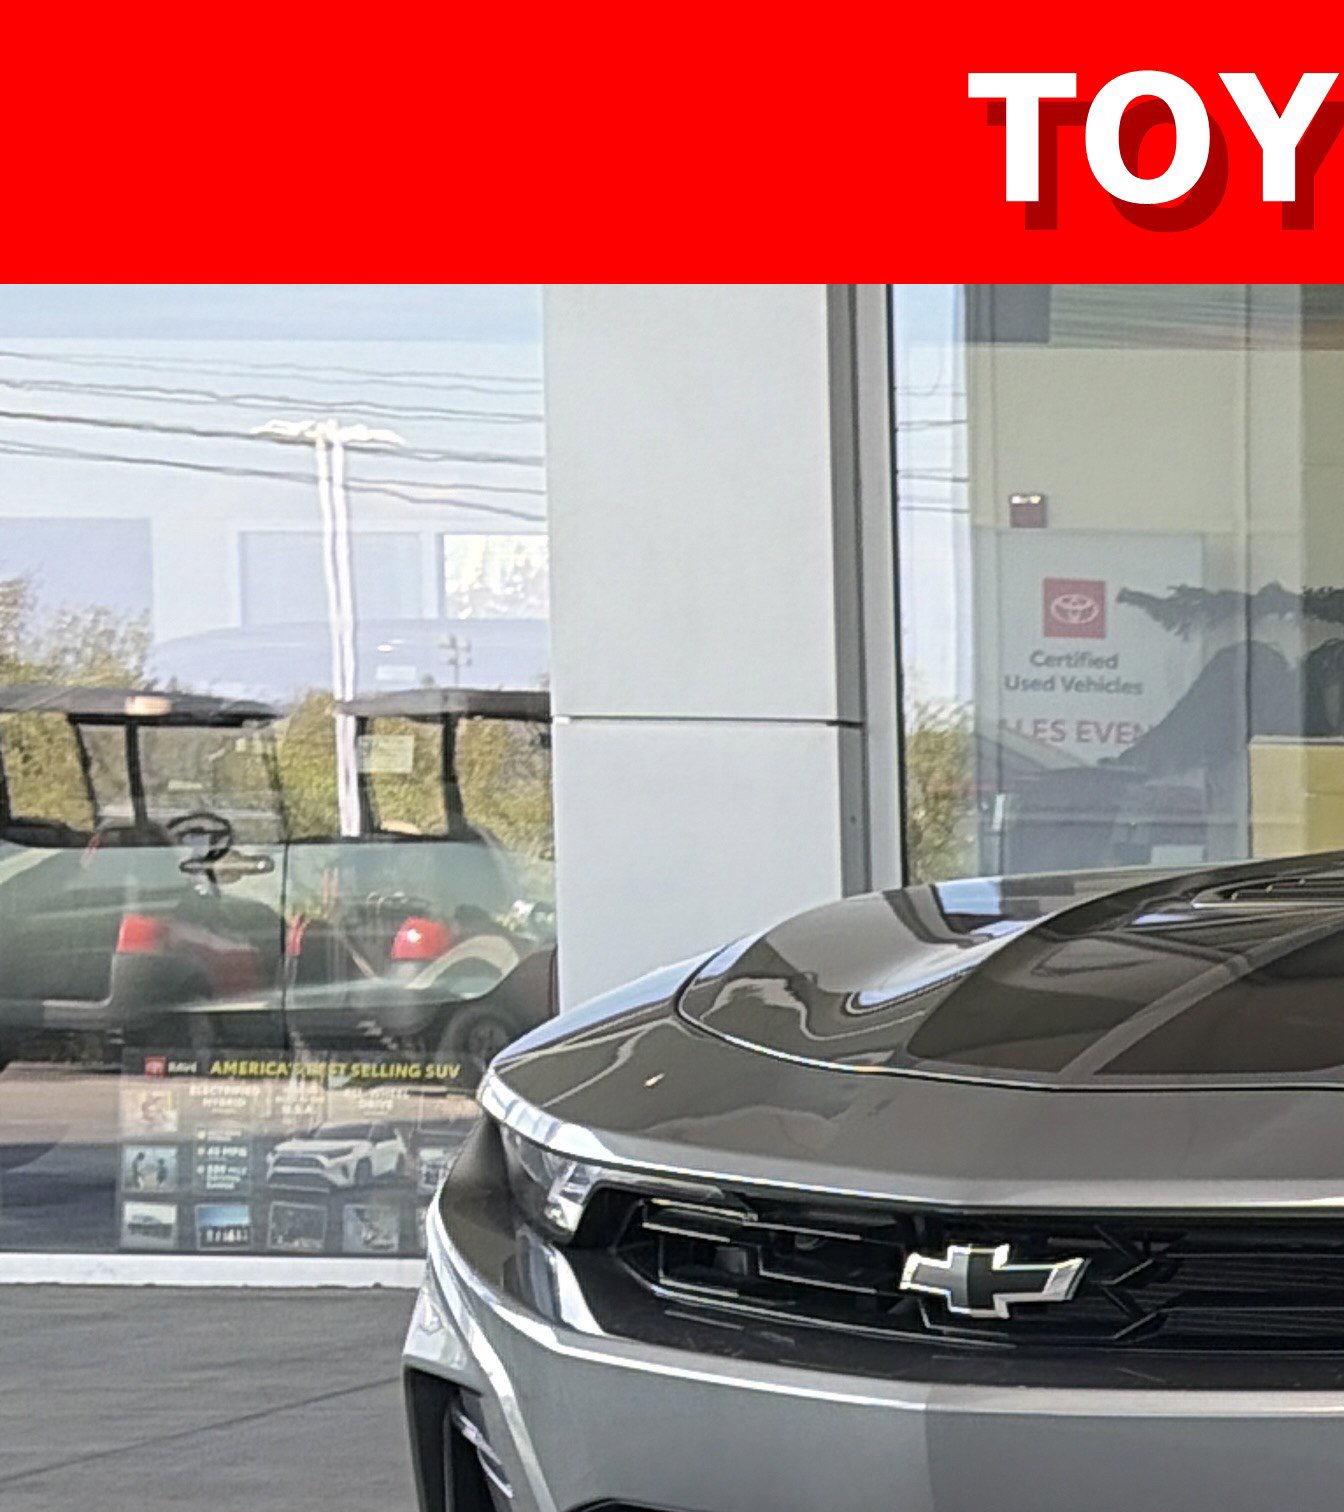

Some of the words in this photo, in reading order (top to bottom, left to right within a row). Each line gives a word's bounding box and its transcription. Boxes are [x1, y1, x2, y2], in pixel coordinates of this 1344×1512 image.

[1029, 650, 1119, 670] Certified
[1004, 674, 1056, 693] Used
[1060, 676, 1144, 696] Vehicles
[350, 1063, 422, 1079] SELLING
[425, 1064, 462, 1079] SUV
